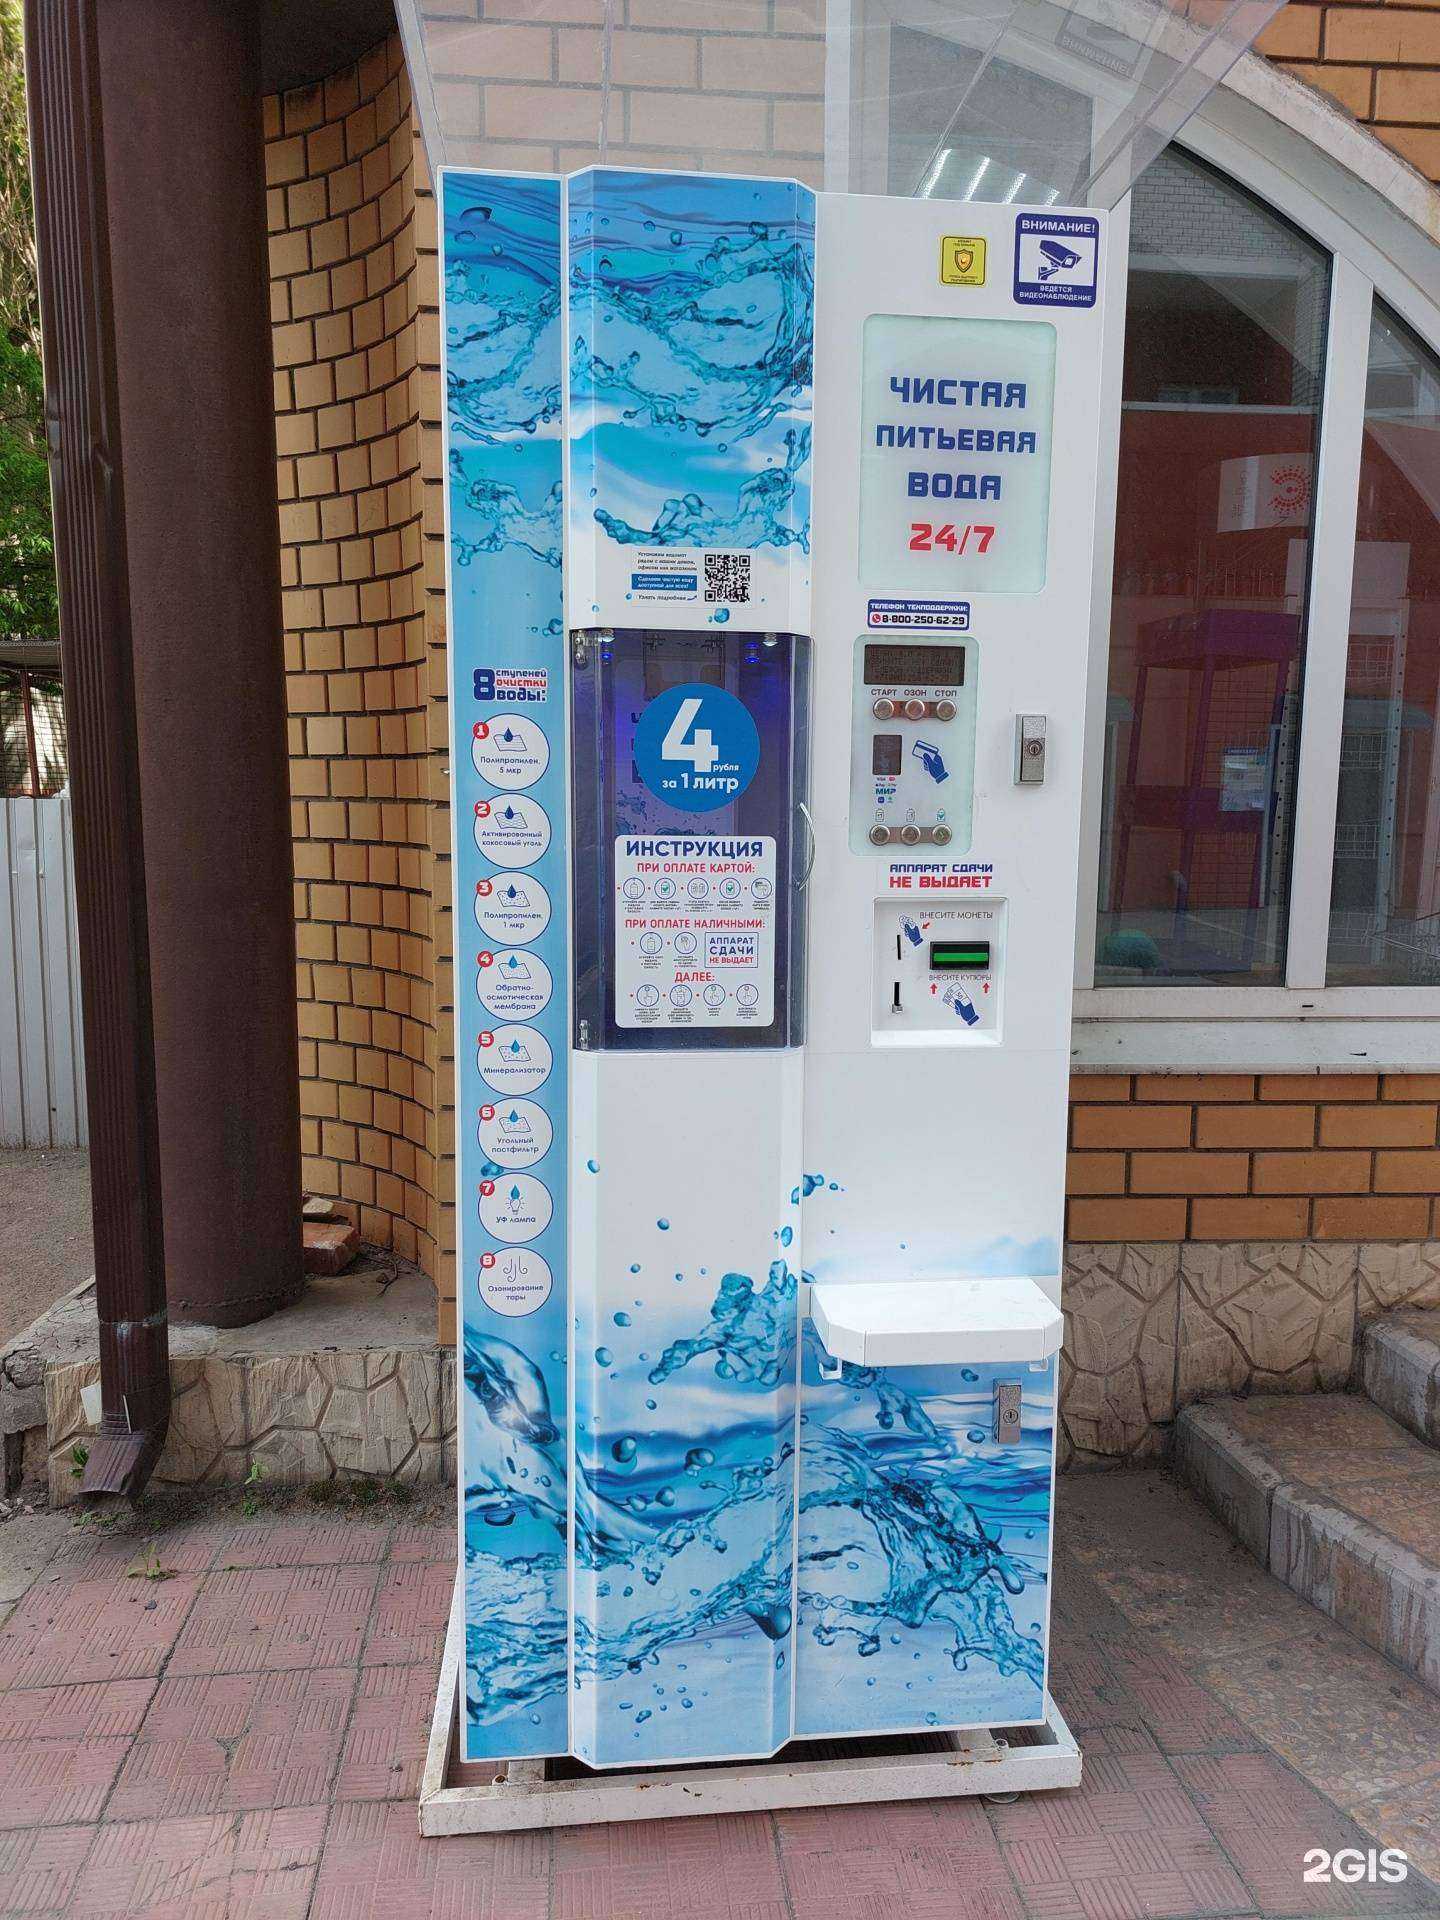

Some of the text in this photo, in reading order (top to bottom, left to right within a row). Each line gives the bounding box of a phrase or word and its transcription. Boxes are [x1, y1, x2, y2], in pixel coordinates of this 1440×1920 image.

[1021, 220, 1095, 233] ВНИМАНИЕ!
[1020, 292, 1092, 302] ВИДЕОНАБЛЮДЕНИЕ
[890, 376, 1027, 408] ЧИСТАЯ
[876, 424, 1036, 454] ПИТЬЕВАЯ
[908, 472, 1002, 500] ВОДА
[909, 523, 996, 555] 24/7
[870, 602, 905, 610] ТЕЛЕФОН
[882, 614, 965, 625] 8-800-250-62-29
[474, 668, 546, 700] 8 ступеней
[497, 688, 546, 702] воды:
[870, 688, 897, 696] СТАРТ
[477, 725, 484, 736] 1
[662, 698, 718, 772] 4
[713, 764, 740, 773] рубля
[662, 773, 739, 793] за 1 литр
[478, 804, 488, 814] 2
[482, 830, 542, 838] Активированный
[626, 840, 762, 860] ИНСТРУКЦИЯ
[637, 862, 756, 874] ПРИ ОПЛАТЕ КАРТОЙ:
[890, 864, 993, 872] АППАРАТ СДАЧИ
[890, 876, 992, 888] НЕ ВЫДАЕТ
[480, 883, 489, 894] 3
[625, 919, 766, 928] ПРИ ОПЛАТЕ НАЛИЧНЫМИ:
[710, 936, 754, 945] АППАРАТ
[710, 946, 754, 956] СДАЧИ
[480, 954, 490, 964] 4
[710, 956, 754, 964] НЕ ВЫДАЕТ
[675, 972, 715, 983] ДАЛЕЕ:
[494, 1002, 536, 1010] мембрана
[482, 1034, 490, 1044] 5
[484, 1067, 546, 1075] Минерализатор
[497, 1136, 534, 1144] Угольный
[492, 1146, 540, 1154] постфильтр
[483, 1184, 492, 1194] 7
[496, 1216, 508, 1224] УФ
[483, 1256, 492, 1266] 8
[488, 1285, 544, 1293] Озонирование
